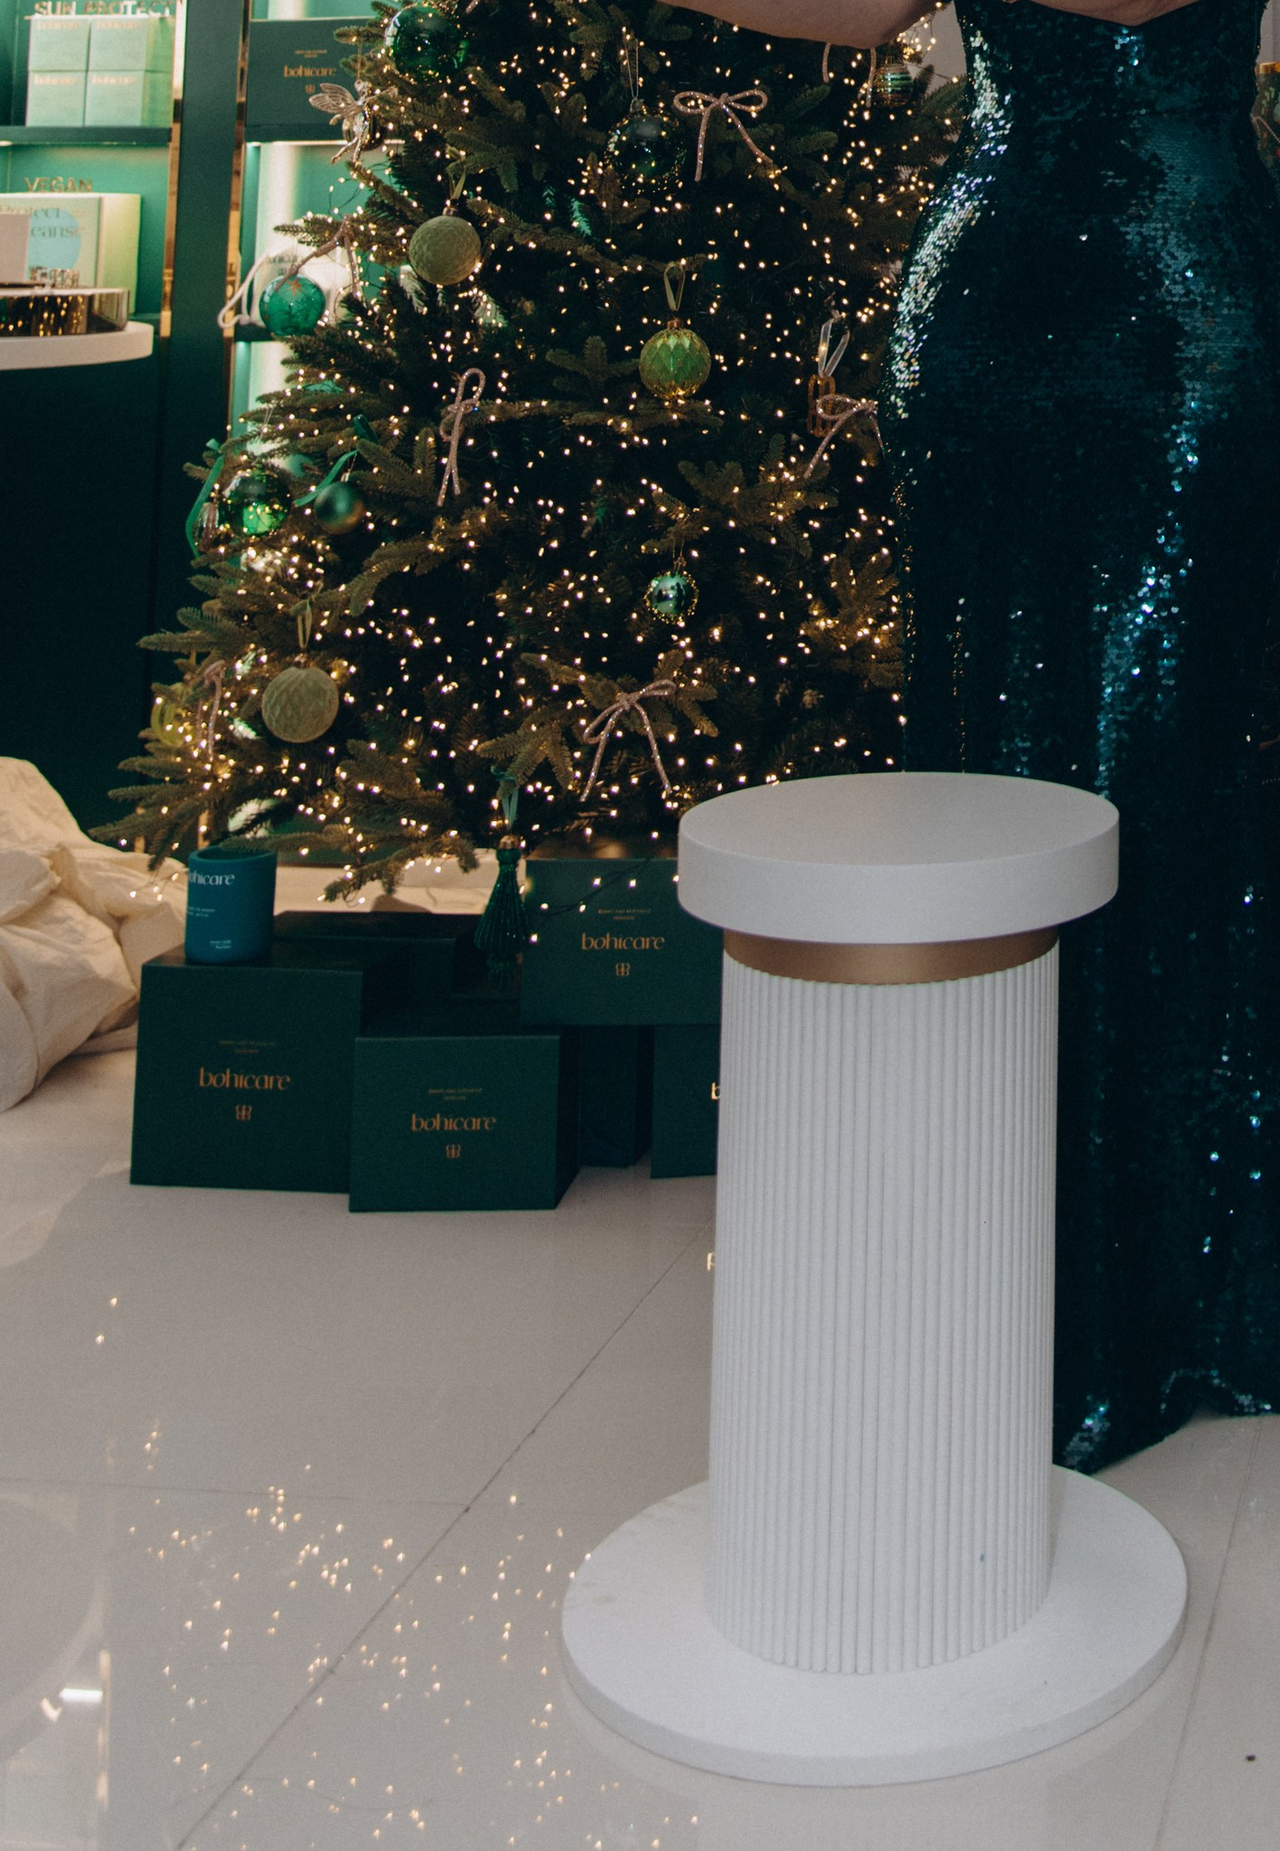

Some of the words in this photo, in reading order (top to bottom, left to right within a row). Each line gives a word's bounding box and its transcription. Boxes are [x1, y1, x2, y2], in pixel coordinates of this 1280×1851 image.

[34, 0, 77, 15] SUN
[25, 176, 93, 193] VEGAN
[581, 932, 665, 950] bohicare
[199, 1066, 291, 1090] bohicare
[411, 1113, 497, 1131] bohicare
